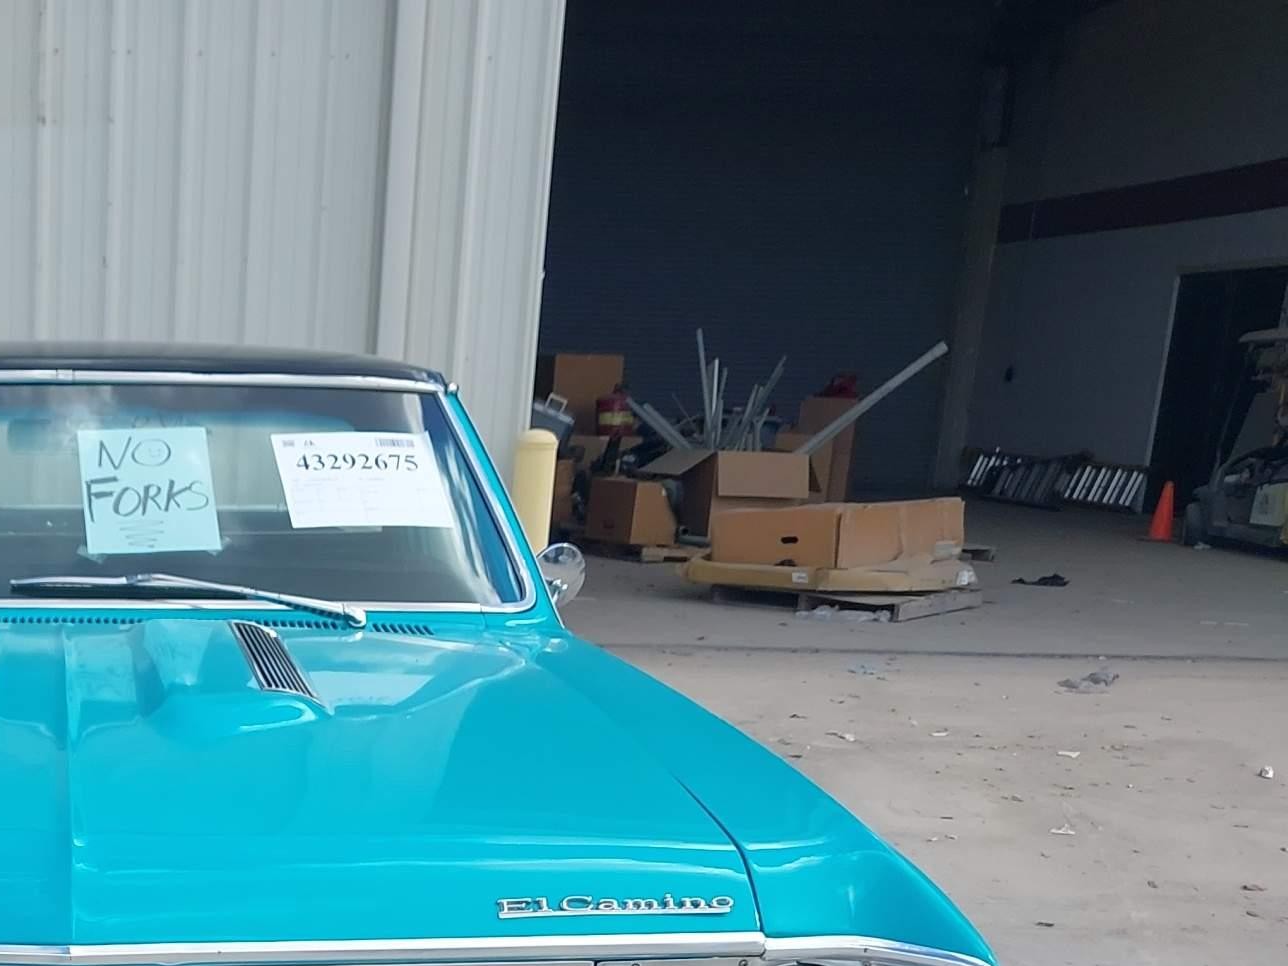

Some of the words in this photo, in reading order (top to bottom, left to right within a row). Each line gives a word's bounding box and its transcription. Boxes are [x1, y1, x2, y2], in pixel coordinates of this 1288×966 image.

[97, 436, 172, 470] NO
[296, 453, 418, 471] 43292675
[85, 476, 210, 523] FORKS
[497, 897, 553, 914] El
[561, 894, 735, 914] Camino
